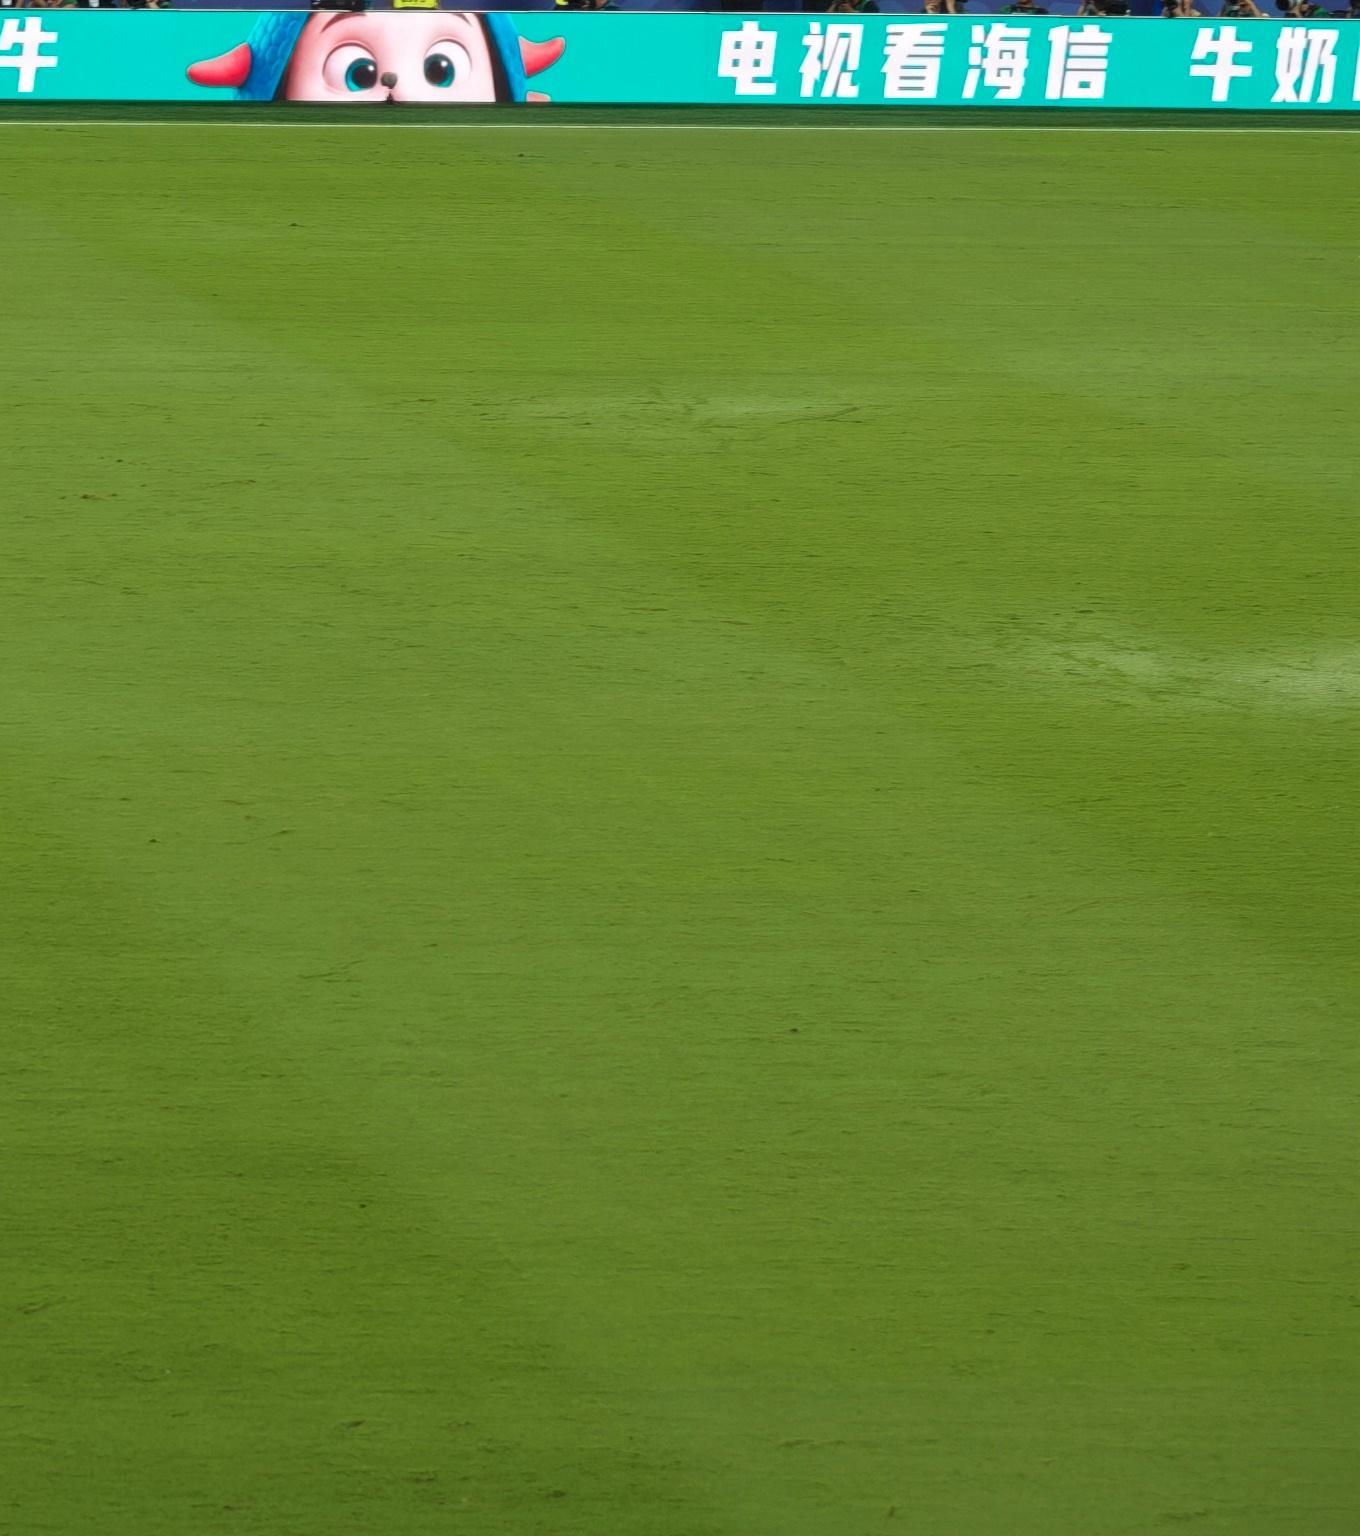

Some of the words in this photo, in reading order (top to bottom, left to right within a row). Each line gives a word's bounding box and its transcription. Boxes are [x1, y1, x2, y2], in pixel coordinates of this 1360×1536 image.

[716, 20, 1113, 100] 电视看海信
[1189, 24, 1360, 104] 牛奶
